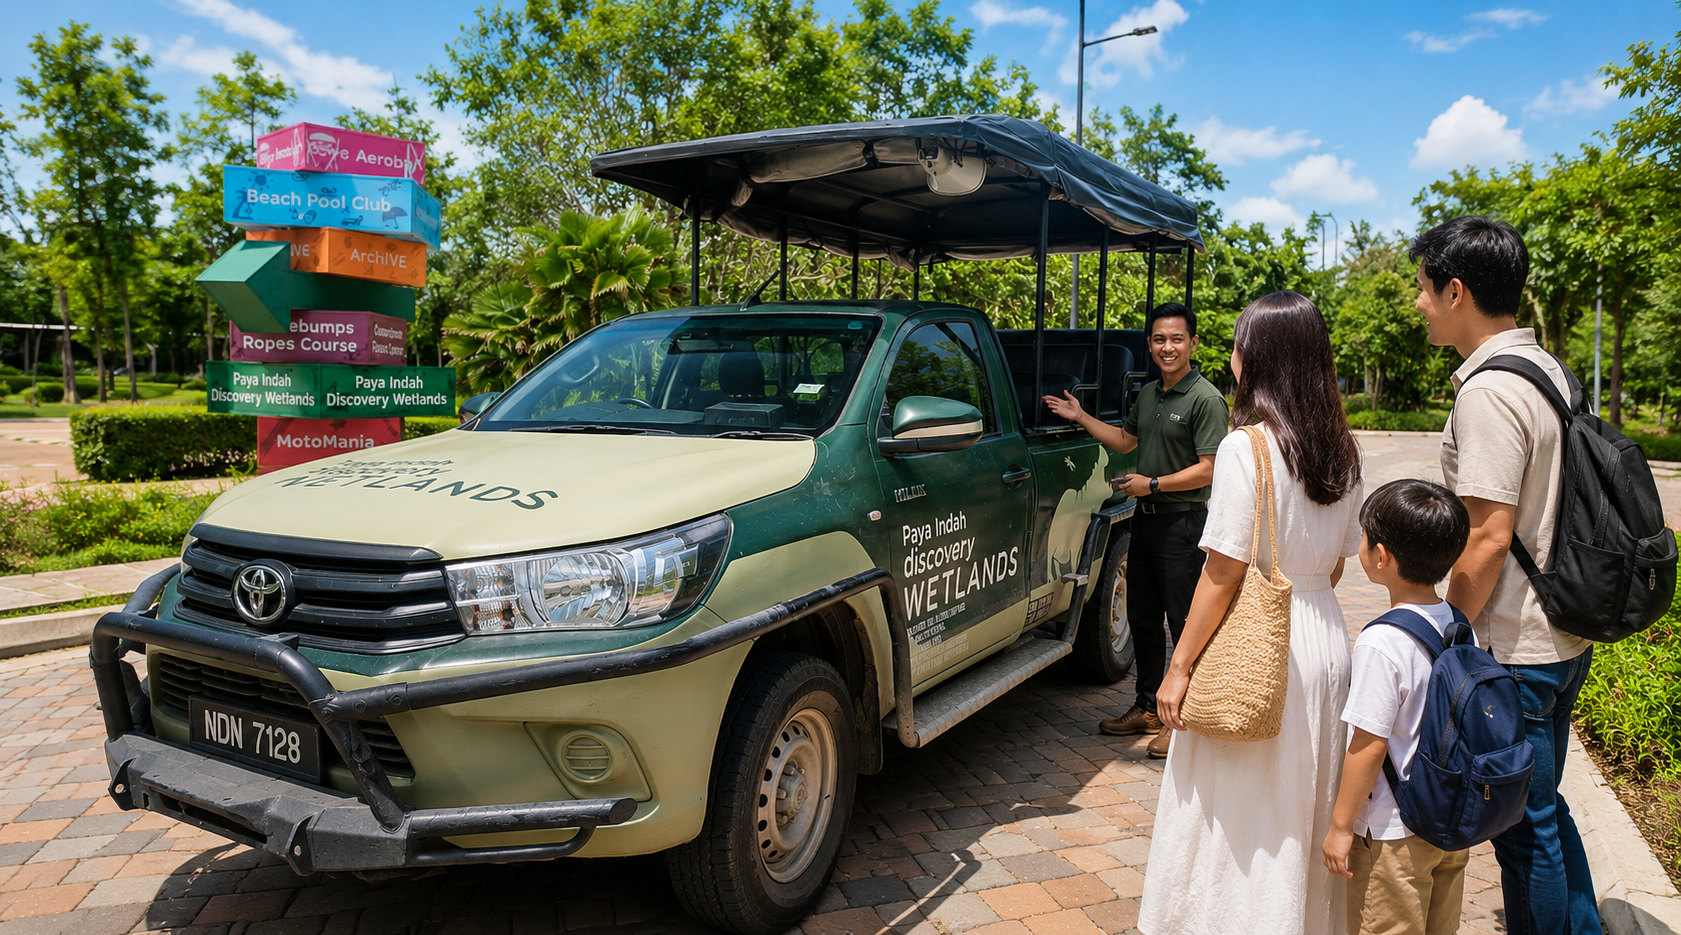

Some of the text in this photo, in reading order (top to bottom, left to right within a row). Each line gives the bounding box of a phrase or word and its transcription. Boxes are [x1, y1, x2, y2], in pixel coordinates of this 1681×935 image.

[247, 189, 391, 212] Beach Pool Club
[350, 248, 407, 268] ArchIVE
[289, 319, 354, 335] ebumps
[242, 335, 295, 352] Ropes
[300, 337, 357, 352] Course
[233, 372, 291, 389] Paya Indah
[355, 375, 423, 390] Paya Indah
[211, 388, 315, 407] Discovery Wetlands
[326, 393, 447, 409] Discovery Wetlands
[276, 434, 375, 449] MotoMania
[902, 511, 967, 547] Paya Indah
[904, 537, 976, 578] discovery
[904, 546, 1018, 621] WETLANDS
[204, 709, 301, 764] NDN 7128
